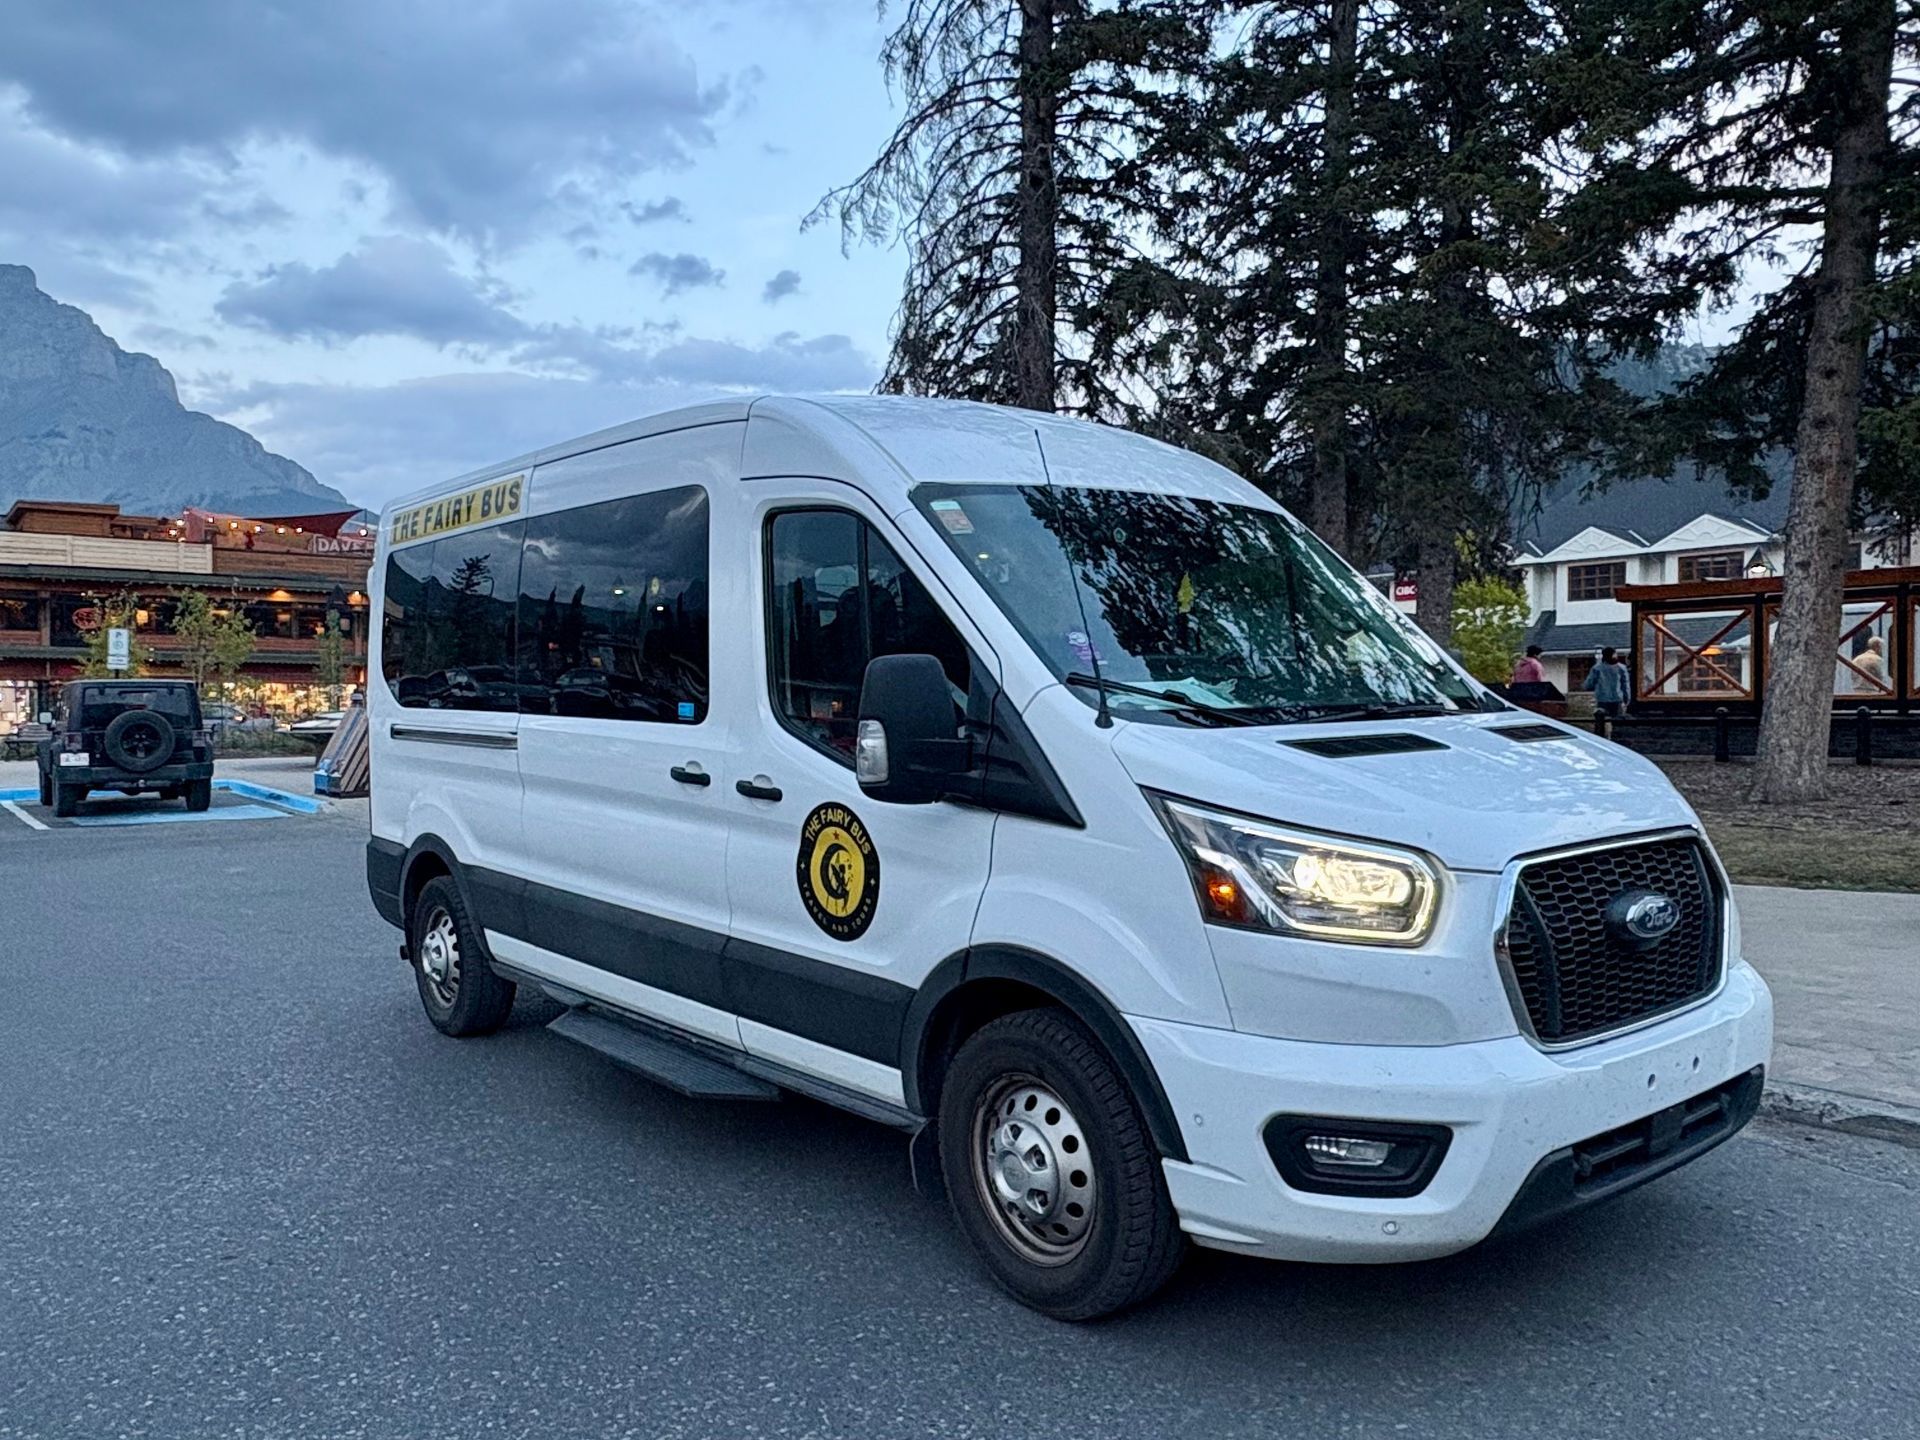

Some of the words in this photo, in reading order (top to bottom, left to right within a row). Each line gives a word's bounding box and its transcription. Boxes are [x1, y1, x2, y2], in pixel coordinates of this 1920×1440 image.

[392, 511, 420, 542] THE
[423, 494, 477, 534] FAIRY
[481, 481, 521, 518] BUS
[805, 814, 821, 842] THE
[820, 808, 850, 828] FAIRY
[850, 823, 871, 855] BUS
[1645, 902, 1674, 929] Ford
